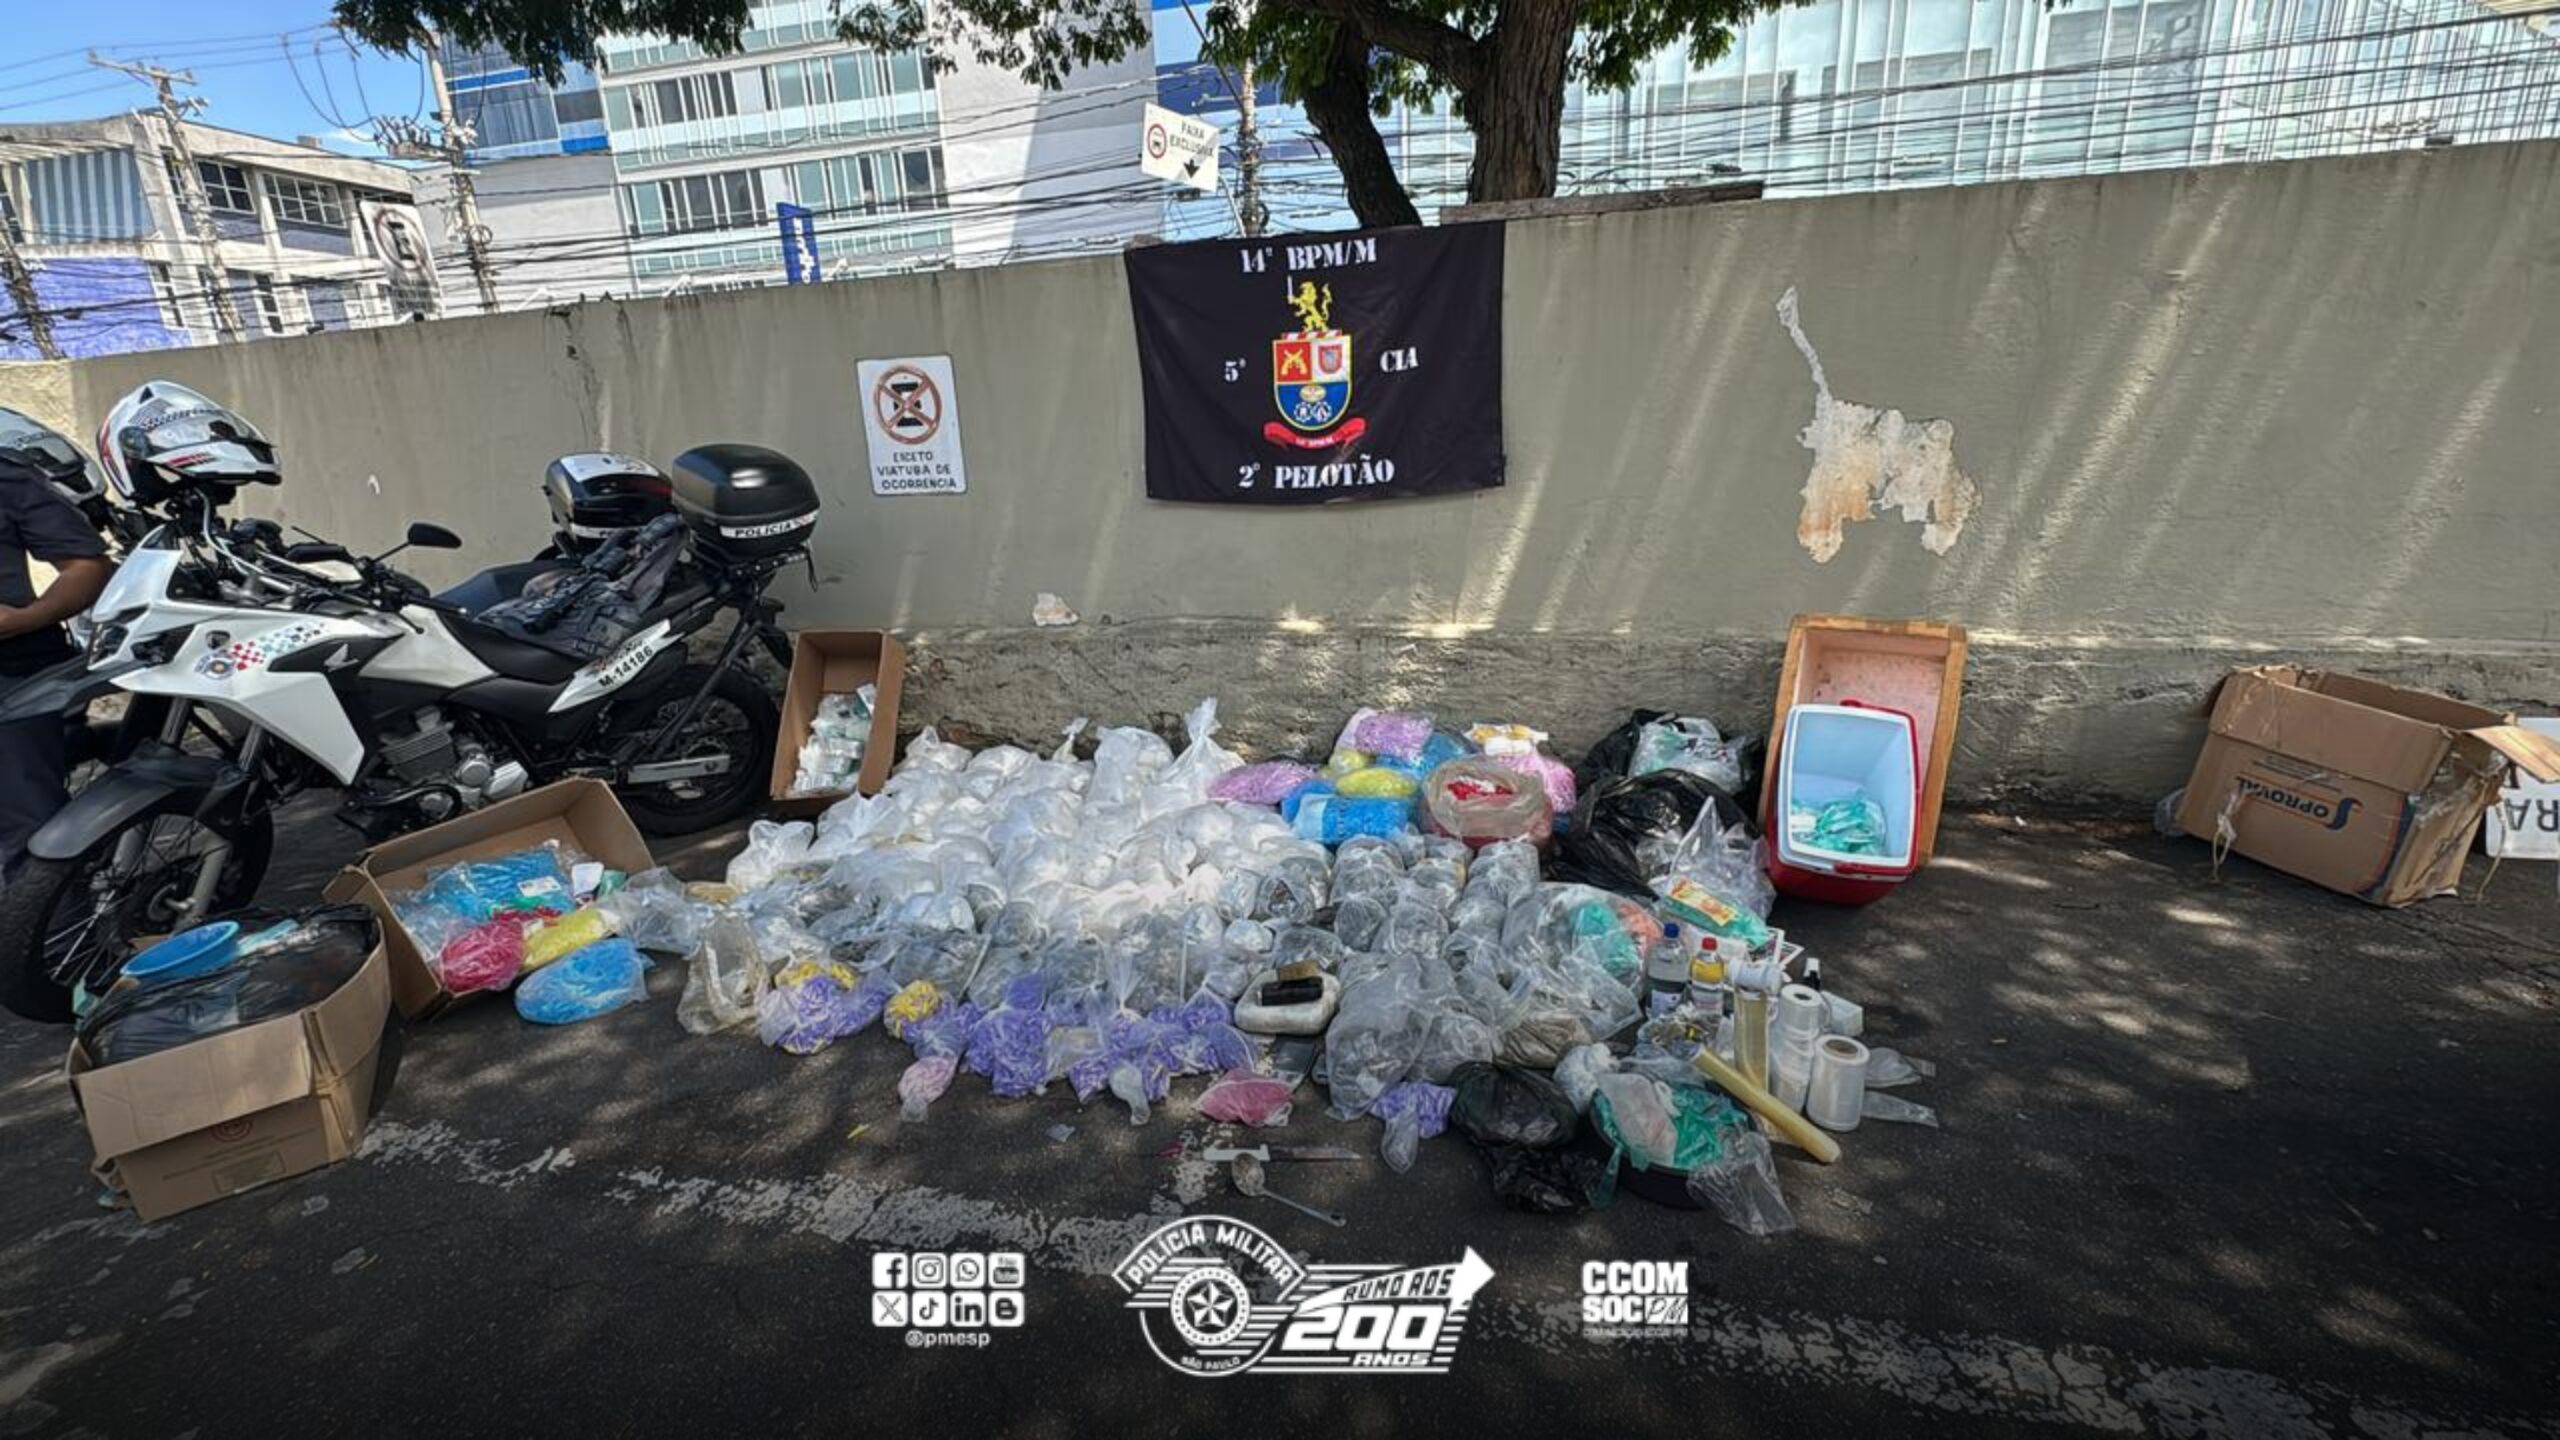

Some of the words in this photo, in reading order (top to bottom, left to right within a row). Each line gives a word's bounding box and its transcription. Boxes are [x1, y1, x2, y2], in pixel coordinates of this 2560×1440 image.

[1286, 237, 1377, 271] BPM/M
[1380, 346, 1419, 373] CIA
[877, 464, 931, 477] VIATURA
[936, 463, 952, 475] DE
[893, 450, 933, 463] EXCETO
[1274, 453, 1395, 489] PELOTÃO
